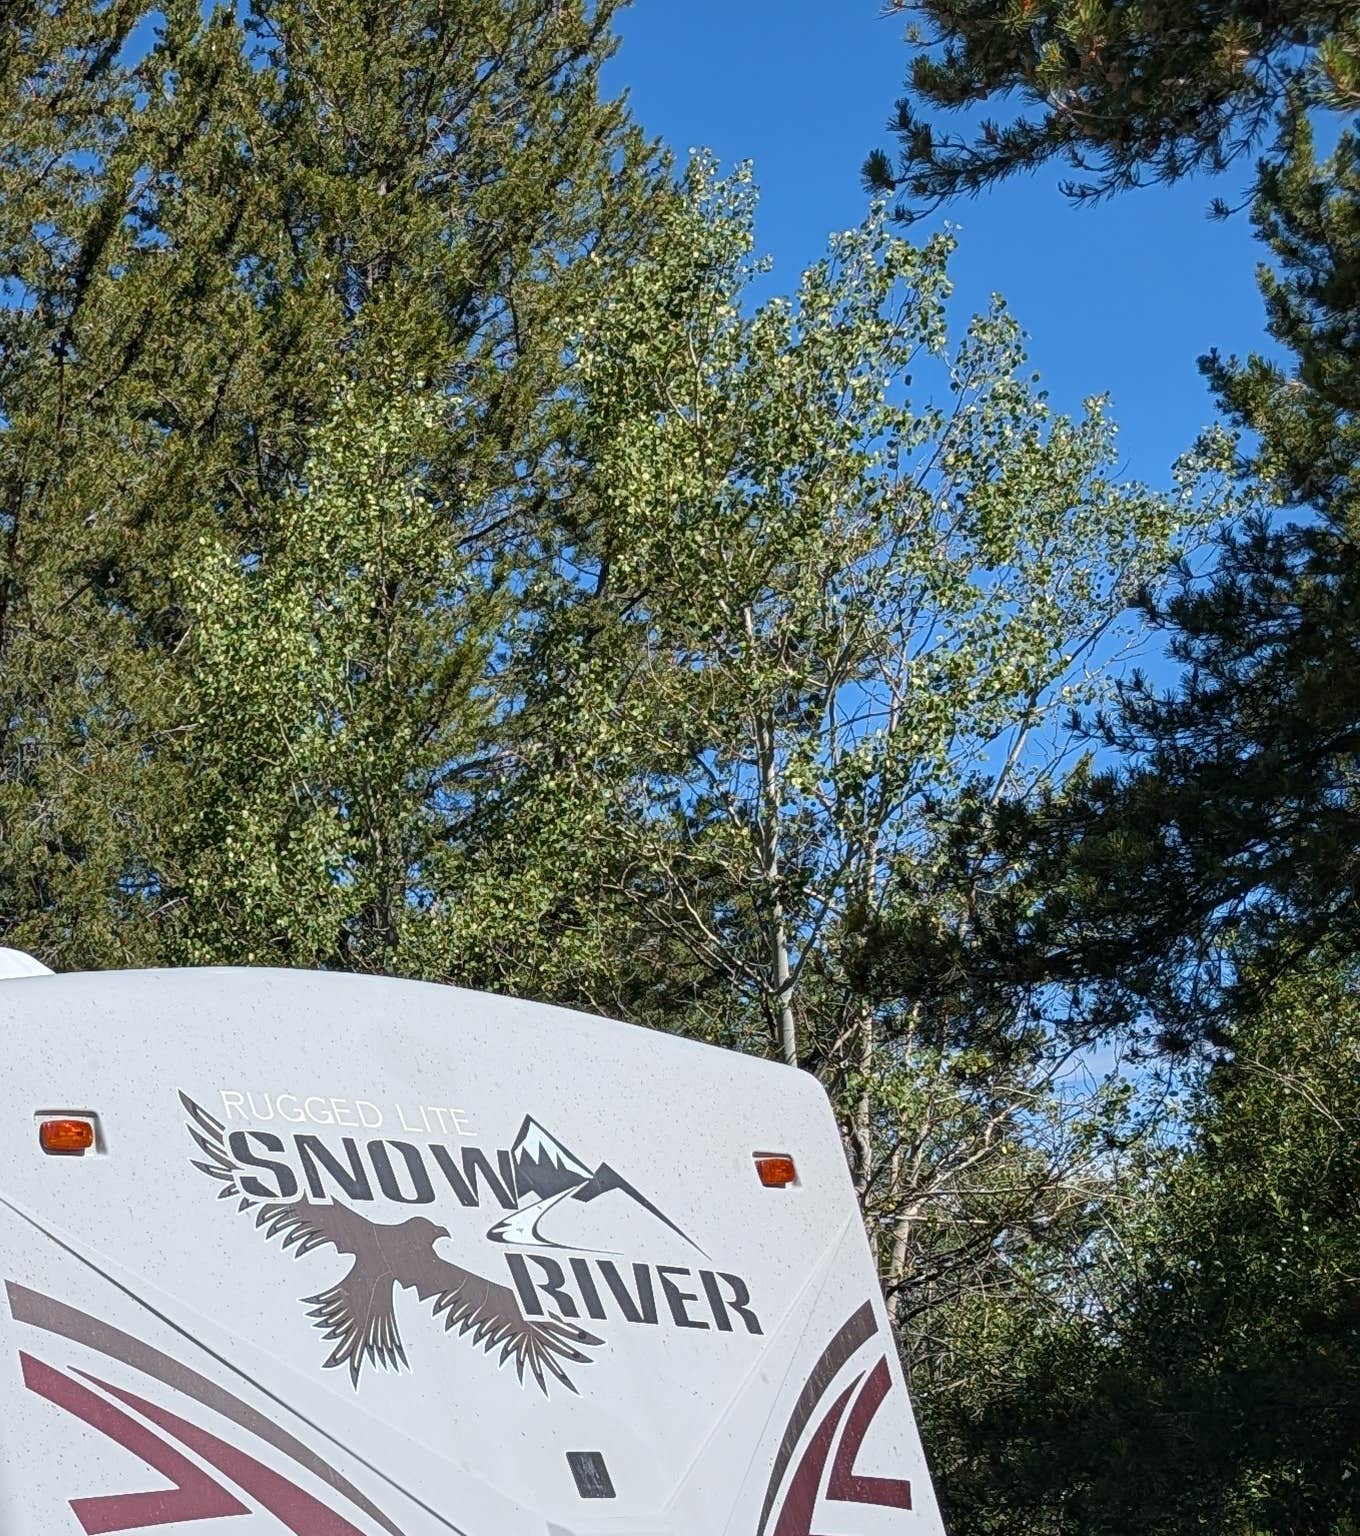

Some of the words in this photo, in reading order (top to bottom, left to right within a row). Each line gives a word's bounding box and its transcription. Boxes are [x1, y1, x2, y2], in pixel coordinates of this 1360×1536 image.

[220, 1090, 382, 1128] RUGGED
[394, 1103, 477, 1136] LITE
[229, 1131, 518, 1210] SNOW
[504, 1253, 764, 1335] RIVER
